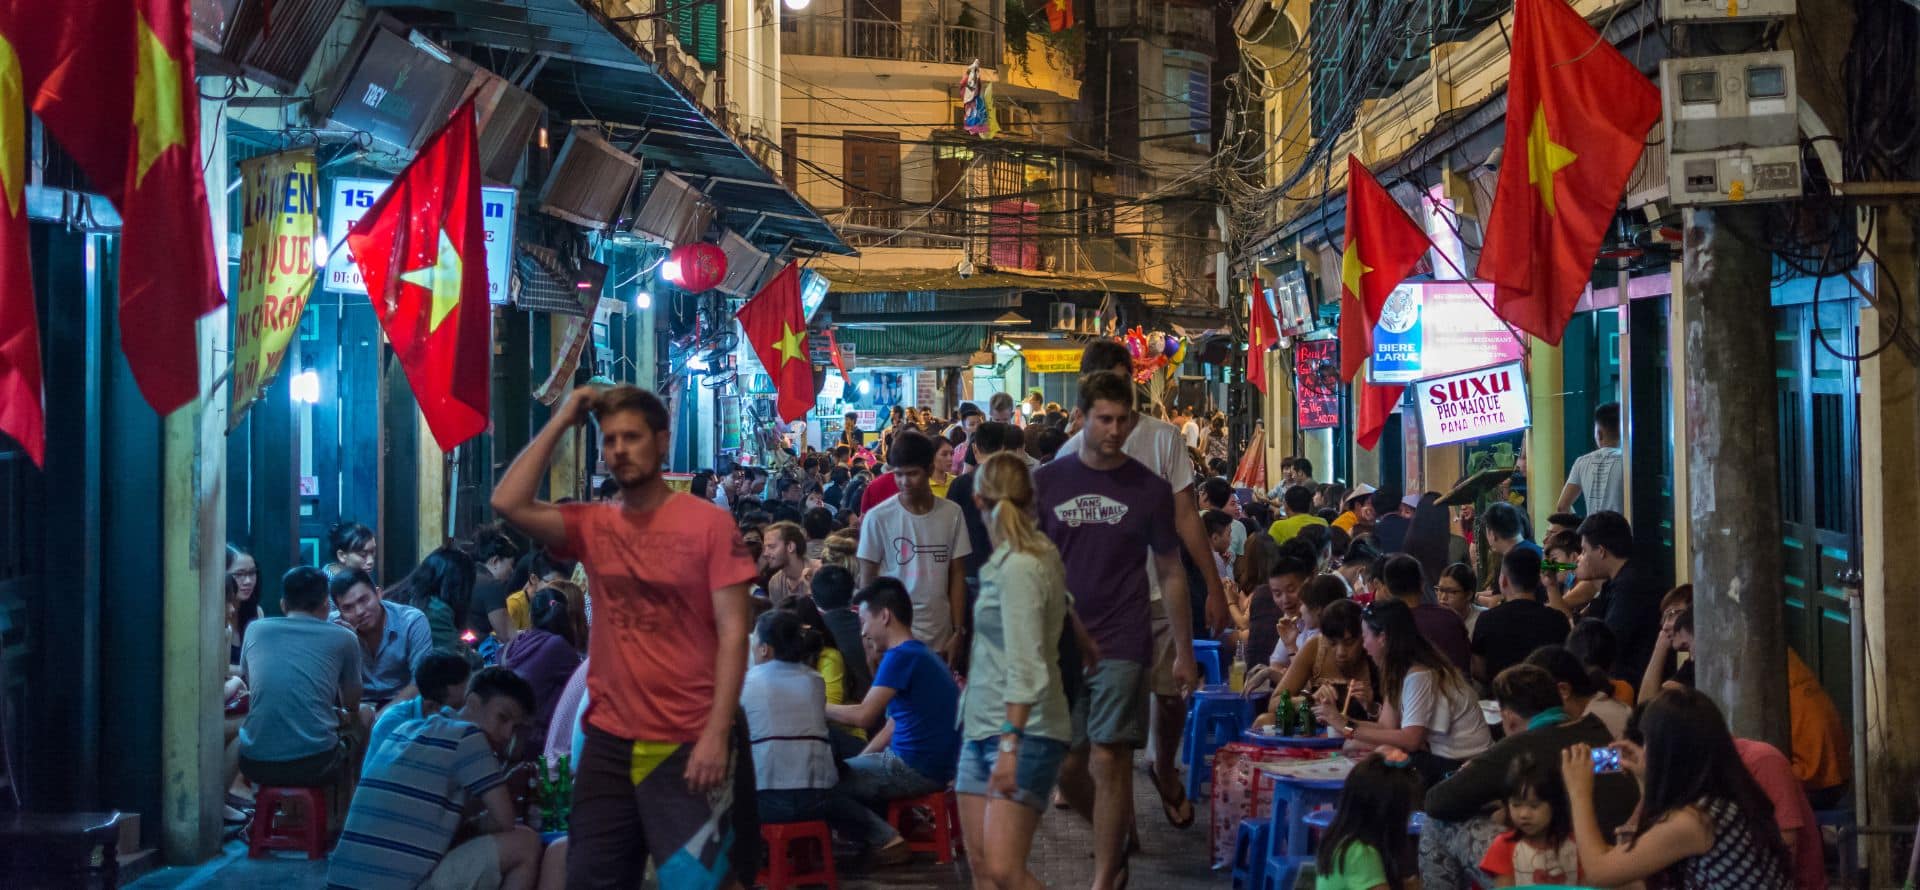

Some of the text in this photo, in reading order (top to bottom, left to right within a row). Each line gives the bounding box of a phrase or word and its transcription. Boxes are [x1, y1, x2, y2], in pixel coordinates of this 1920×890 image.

[1378, 343, 1416, 352] BIERE
[1429, 371, 1511, 405] SUXU
[1437, 402, 1458, 420] PHO
[1075, 497, 1101, 509] VANS
[1062, 504, 1121, 520] OFF THE WALL
